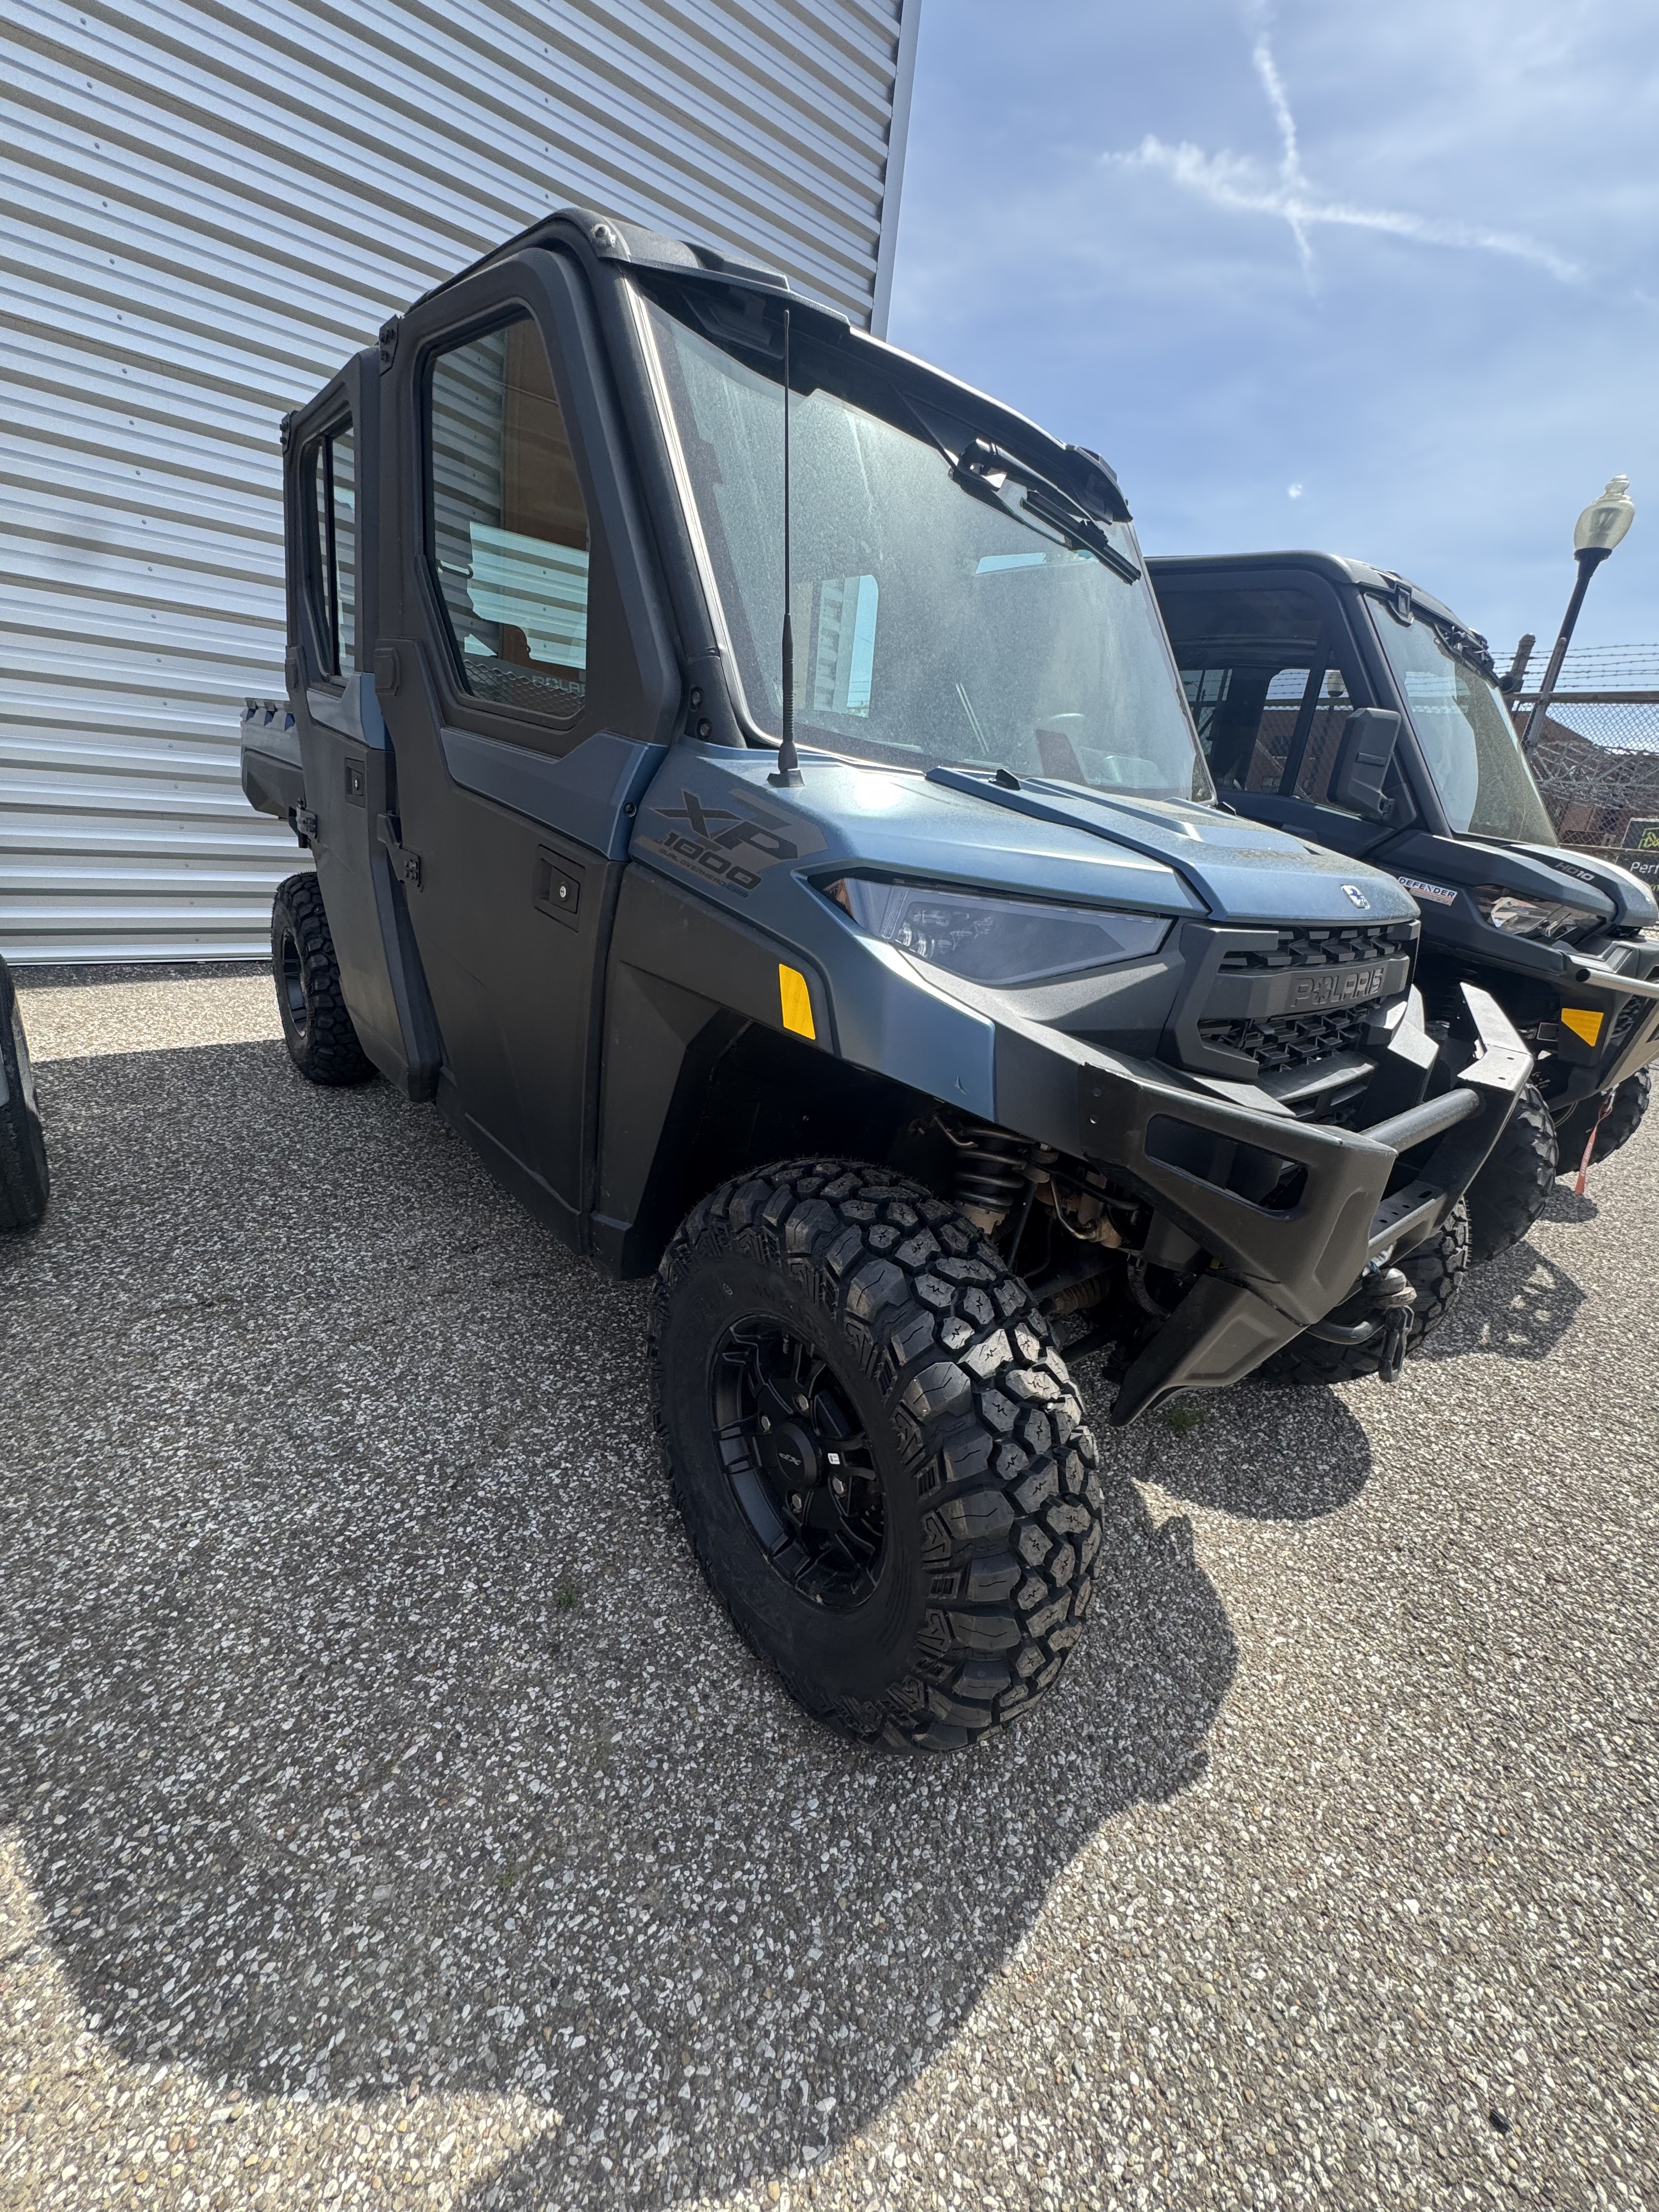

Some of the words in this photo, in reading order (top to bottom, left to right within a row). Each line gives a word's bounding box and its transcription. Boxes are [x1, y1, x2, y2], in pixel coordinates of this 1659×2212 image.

[648, 788, 799, 860] XP
[659, 848, 679, 862] DUAL
[679, 860, 726, 887] OVERHEAD
[726, 884, 749, 899] CAM
[662, 830, 763, 891] 1000
[1555, 862, 1595, 881] HD10
[1398, 877, 1455, 899] DEFENDER
[1290, 968, 1384, 1008] POLARIS
